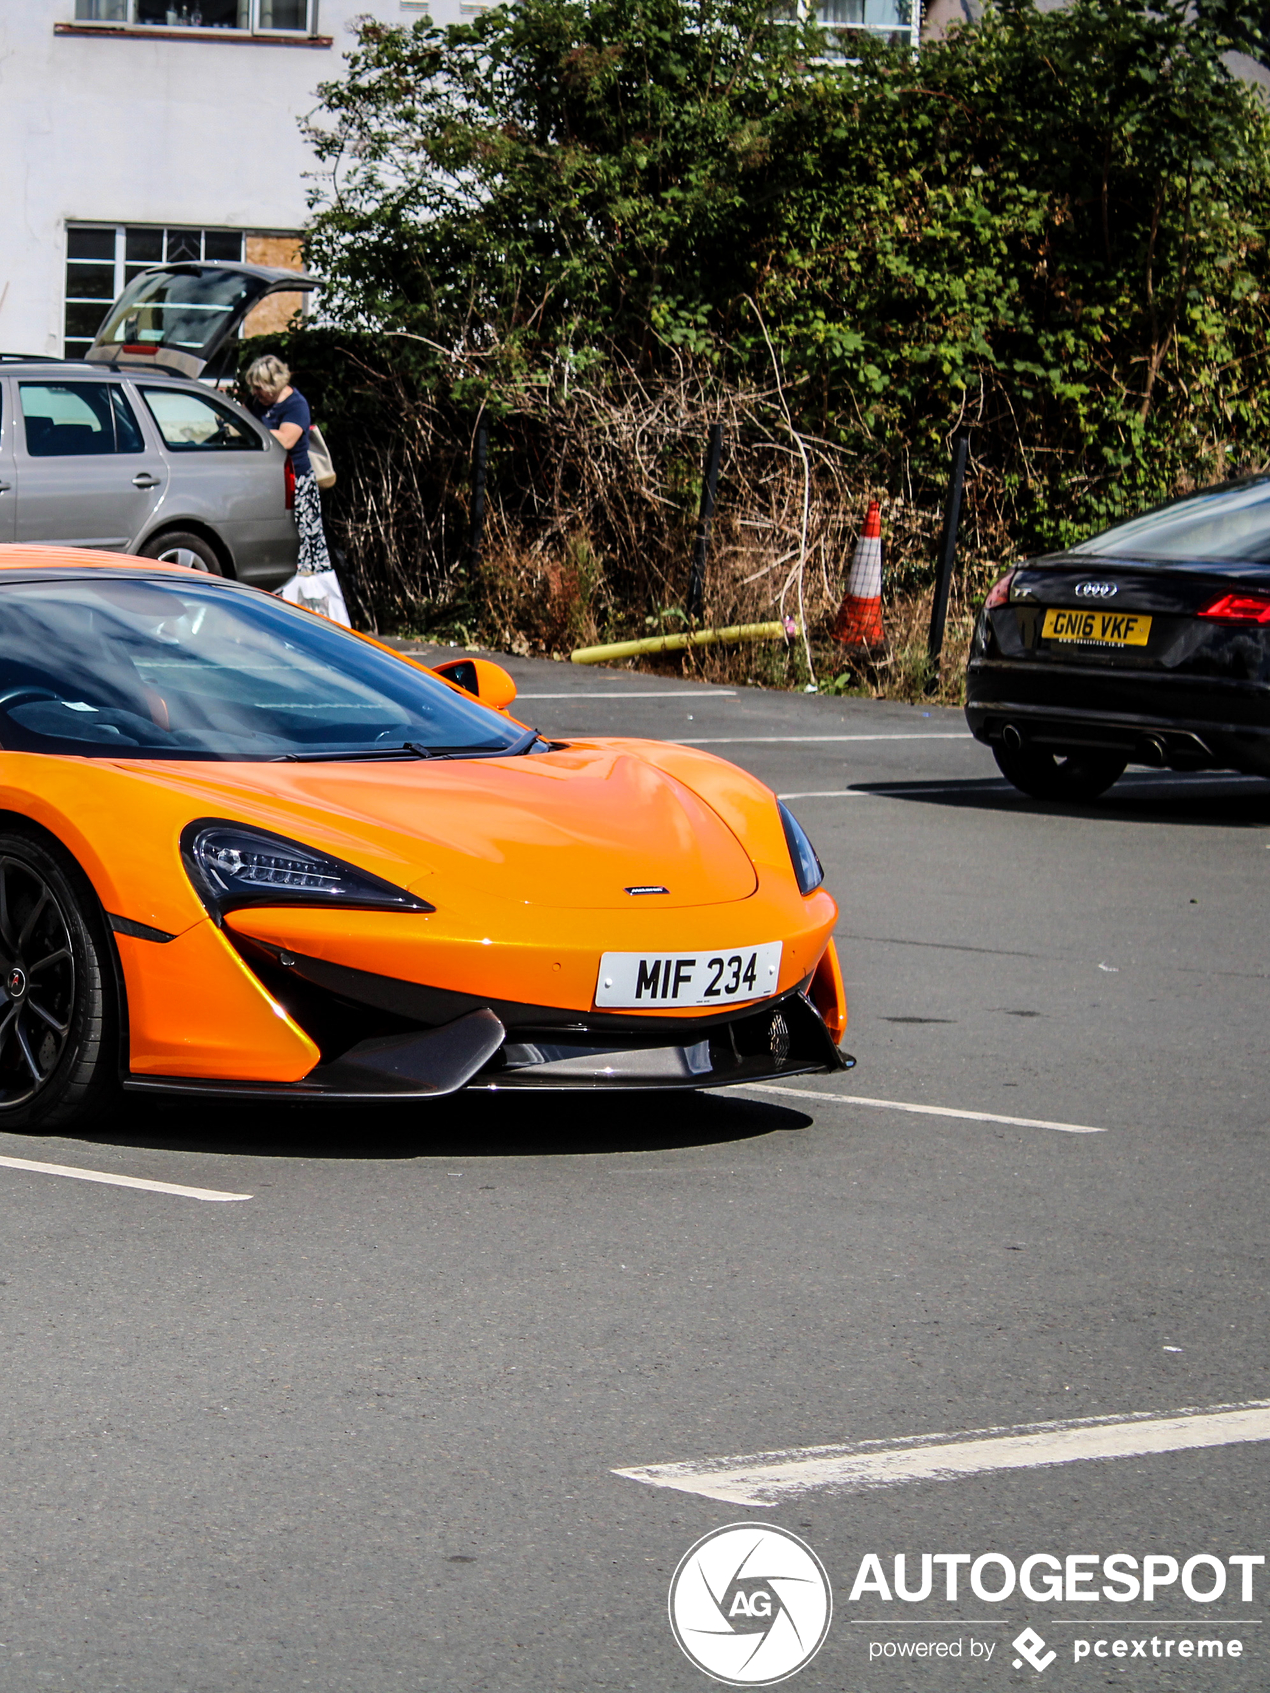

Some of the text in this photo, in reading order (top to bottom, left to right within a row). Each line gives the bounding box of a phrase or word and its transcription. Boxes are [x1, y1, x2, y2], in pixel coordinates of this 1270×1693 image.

[1052, 612, 1139, 640] GN16 VKF
[634, 952, 758, 999] MIF 234
